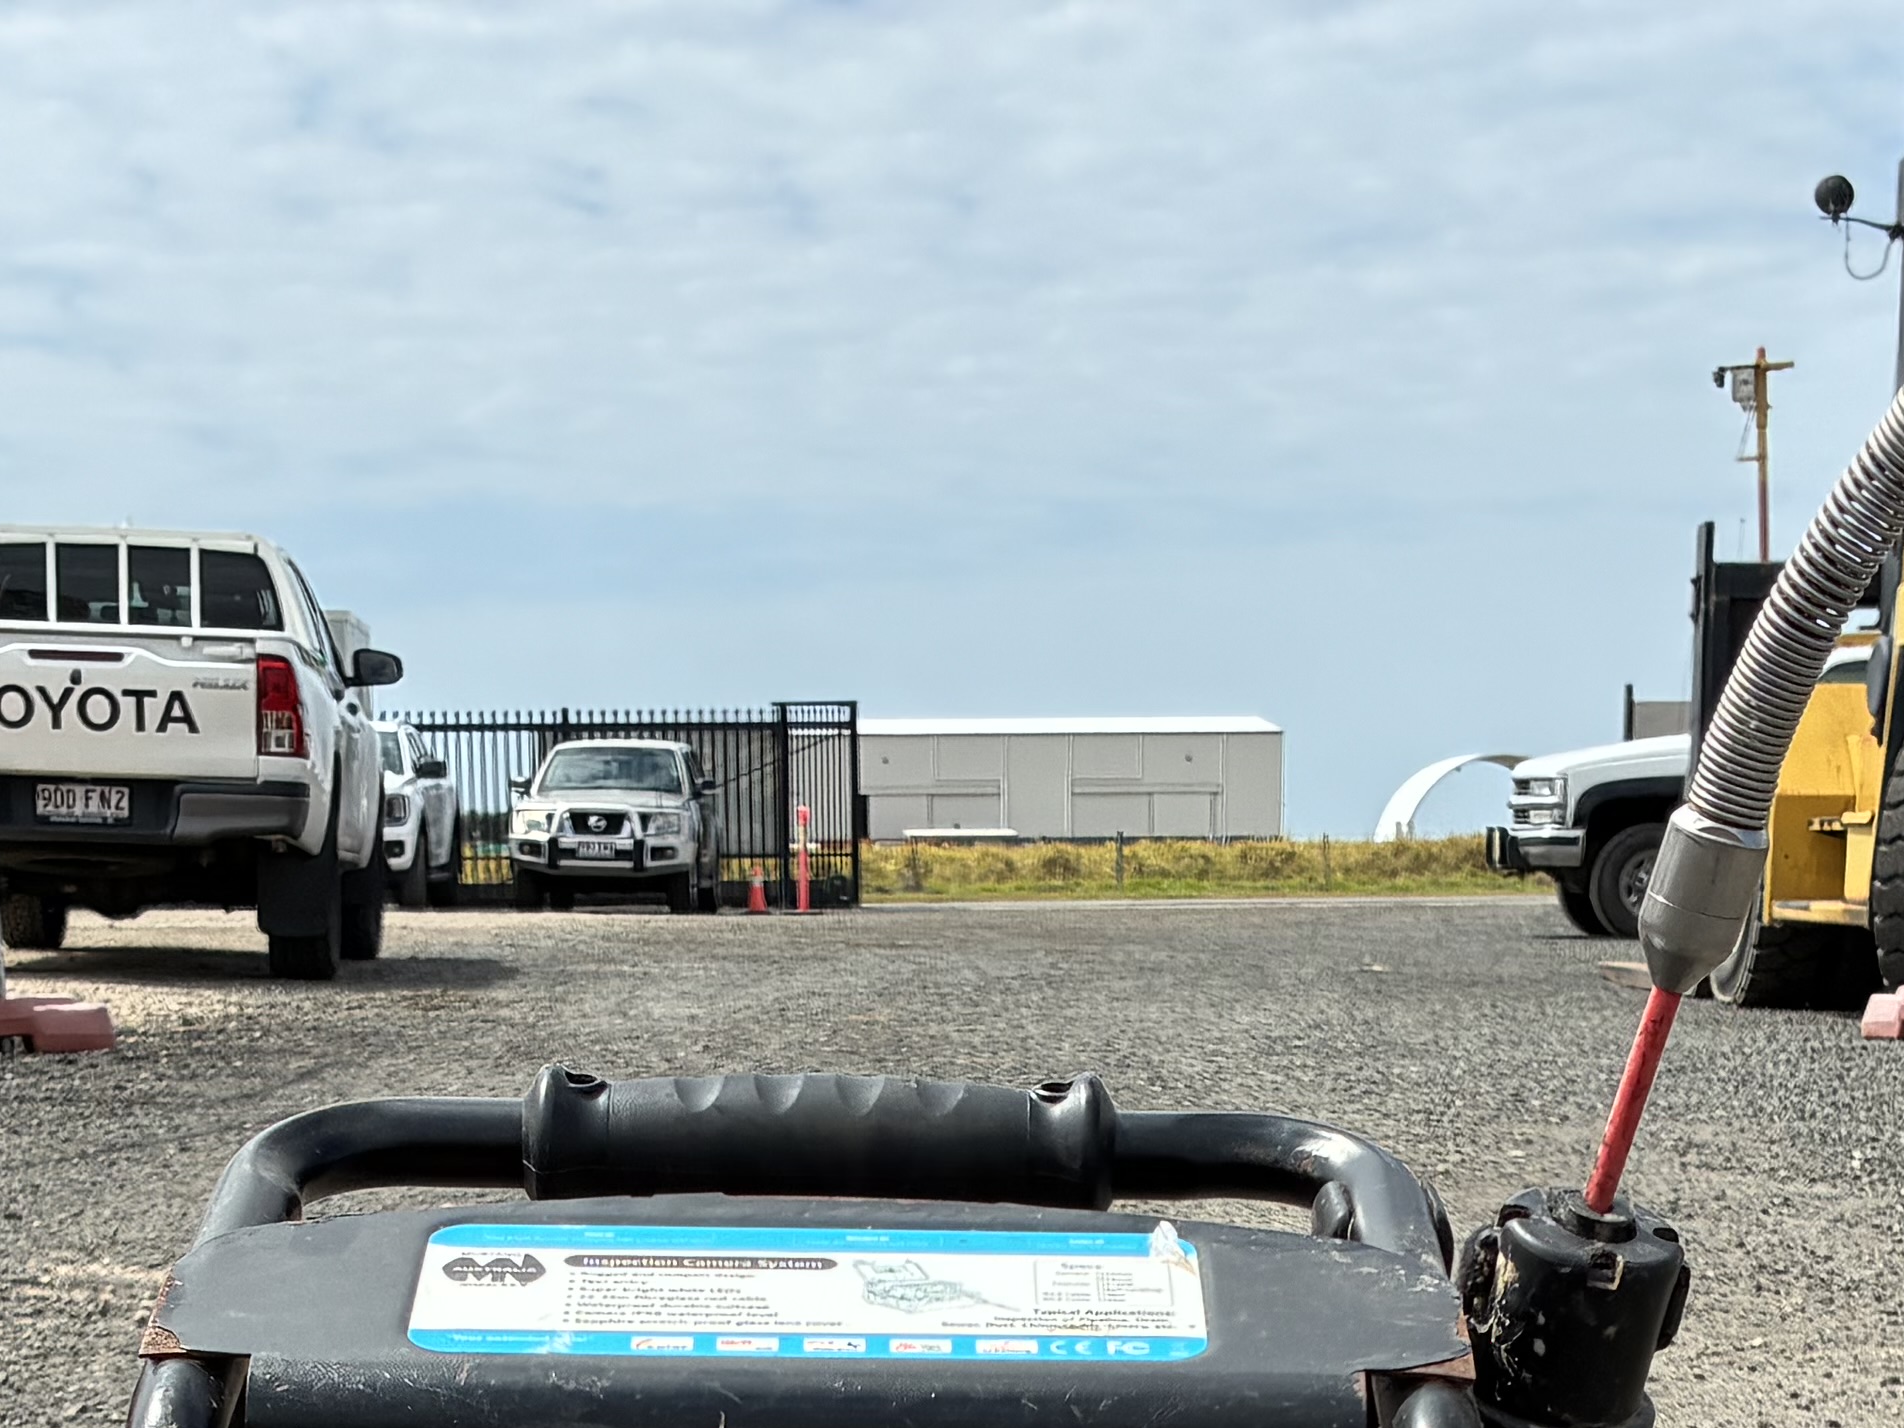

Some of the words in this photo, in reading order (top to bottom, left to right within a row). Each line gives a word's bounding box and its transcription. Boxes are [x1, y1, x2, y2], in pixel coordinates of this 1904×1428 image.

[582, 1256, 678, 1269] Inspection
[682, 1258, 753, 1268] Camera
[757, 1259, 823, 1270] System
